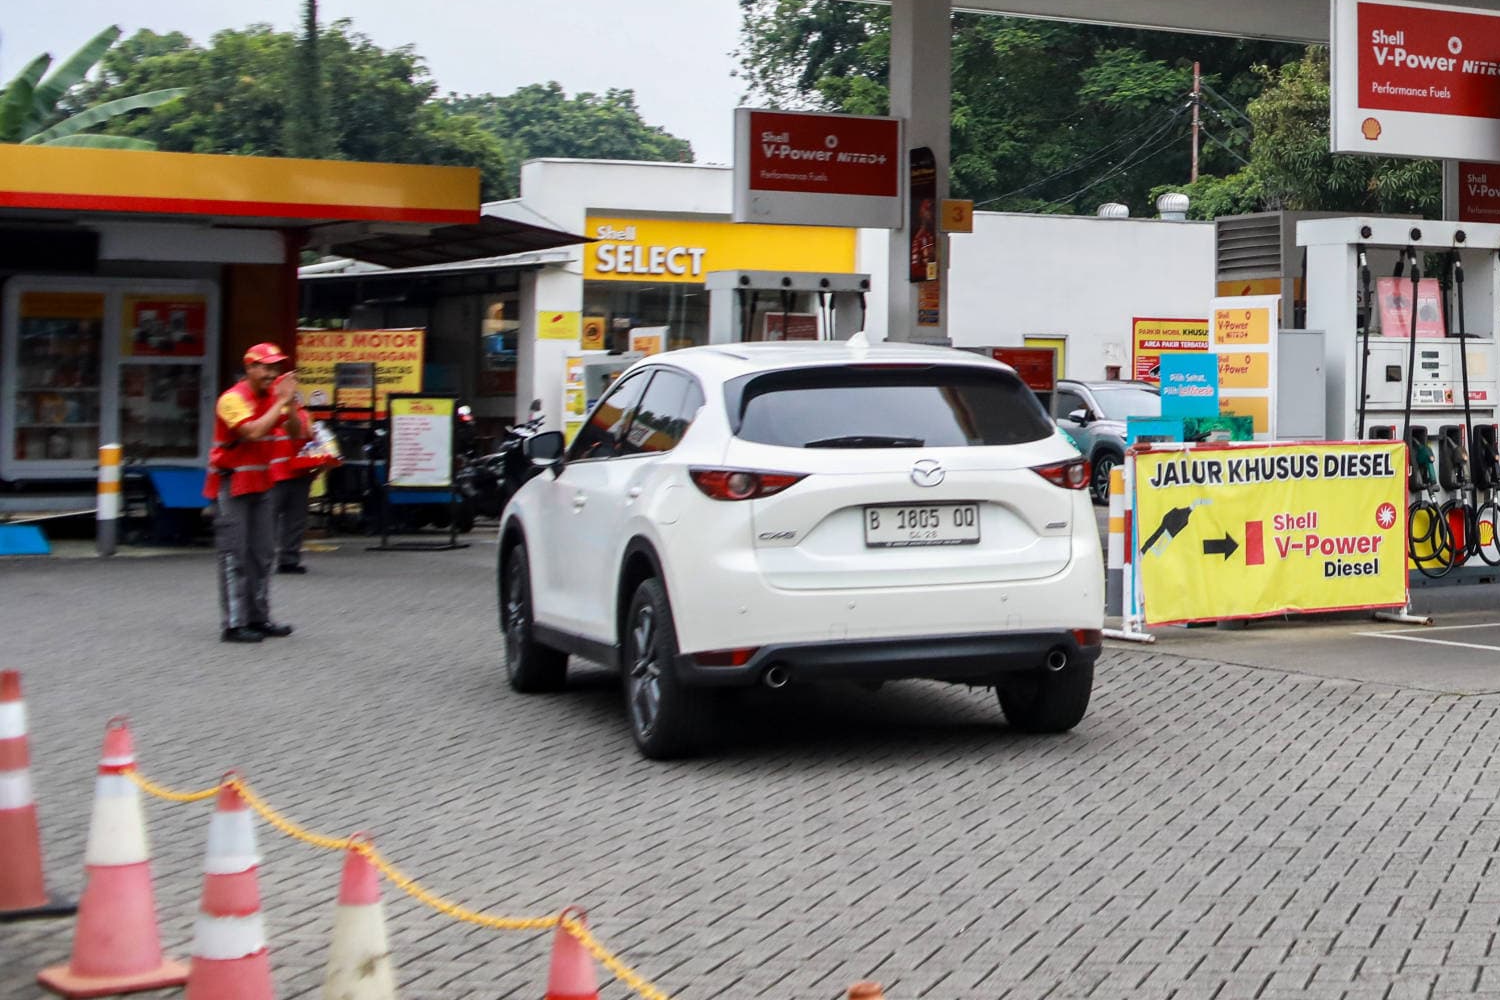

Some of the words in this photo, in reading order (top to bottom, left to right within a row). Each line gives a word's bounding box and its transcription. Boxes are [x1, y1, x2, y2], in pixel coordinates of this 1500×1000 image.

[1372, 29, 1404, 46] Shell
[1373, 46, 1457, 72] V-Power
[1372, 81, 1428, 98] Performance
[1429, 86, 1451, 99] Fuels
[761, 131, 790, 144] Shell
[763, 143, 833, 162] V-Power
[760, 169, 808, 181] Performance
[808, 172, 828, 182] Fuels
[1467, 173, 1487, 184] Shell
[952, 206, 963, 222] 3
[596, 225, 637, 241] Shell
[596, 244, 706, 276] SELECT
[1218, 320, 1248, 331] V-Power
[351, 334, 417, 348] MOTOR
[1150, 459, 1222, 488] JALUR
[1228, 454, 1319, 484] KHUSUS
[1324, 452, 1395, 479] DIESEL
[869, 510, 880, 530] B
[1273, 511, 1318, 531] Shell
[1274, 533, 1382, 560] V-Power
[1324, 558, 1379, 577] Diesel
